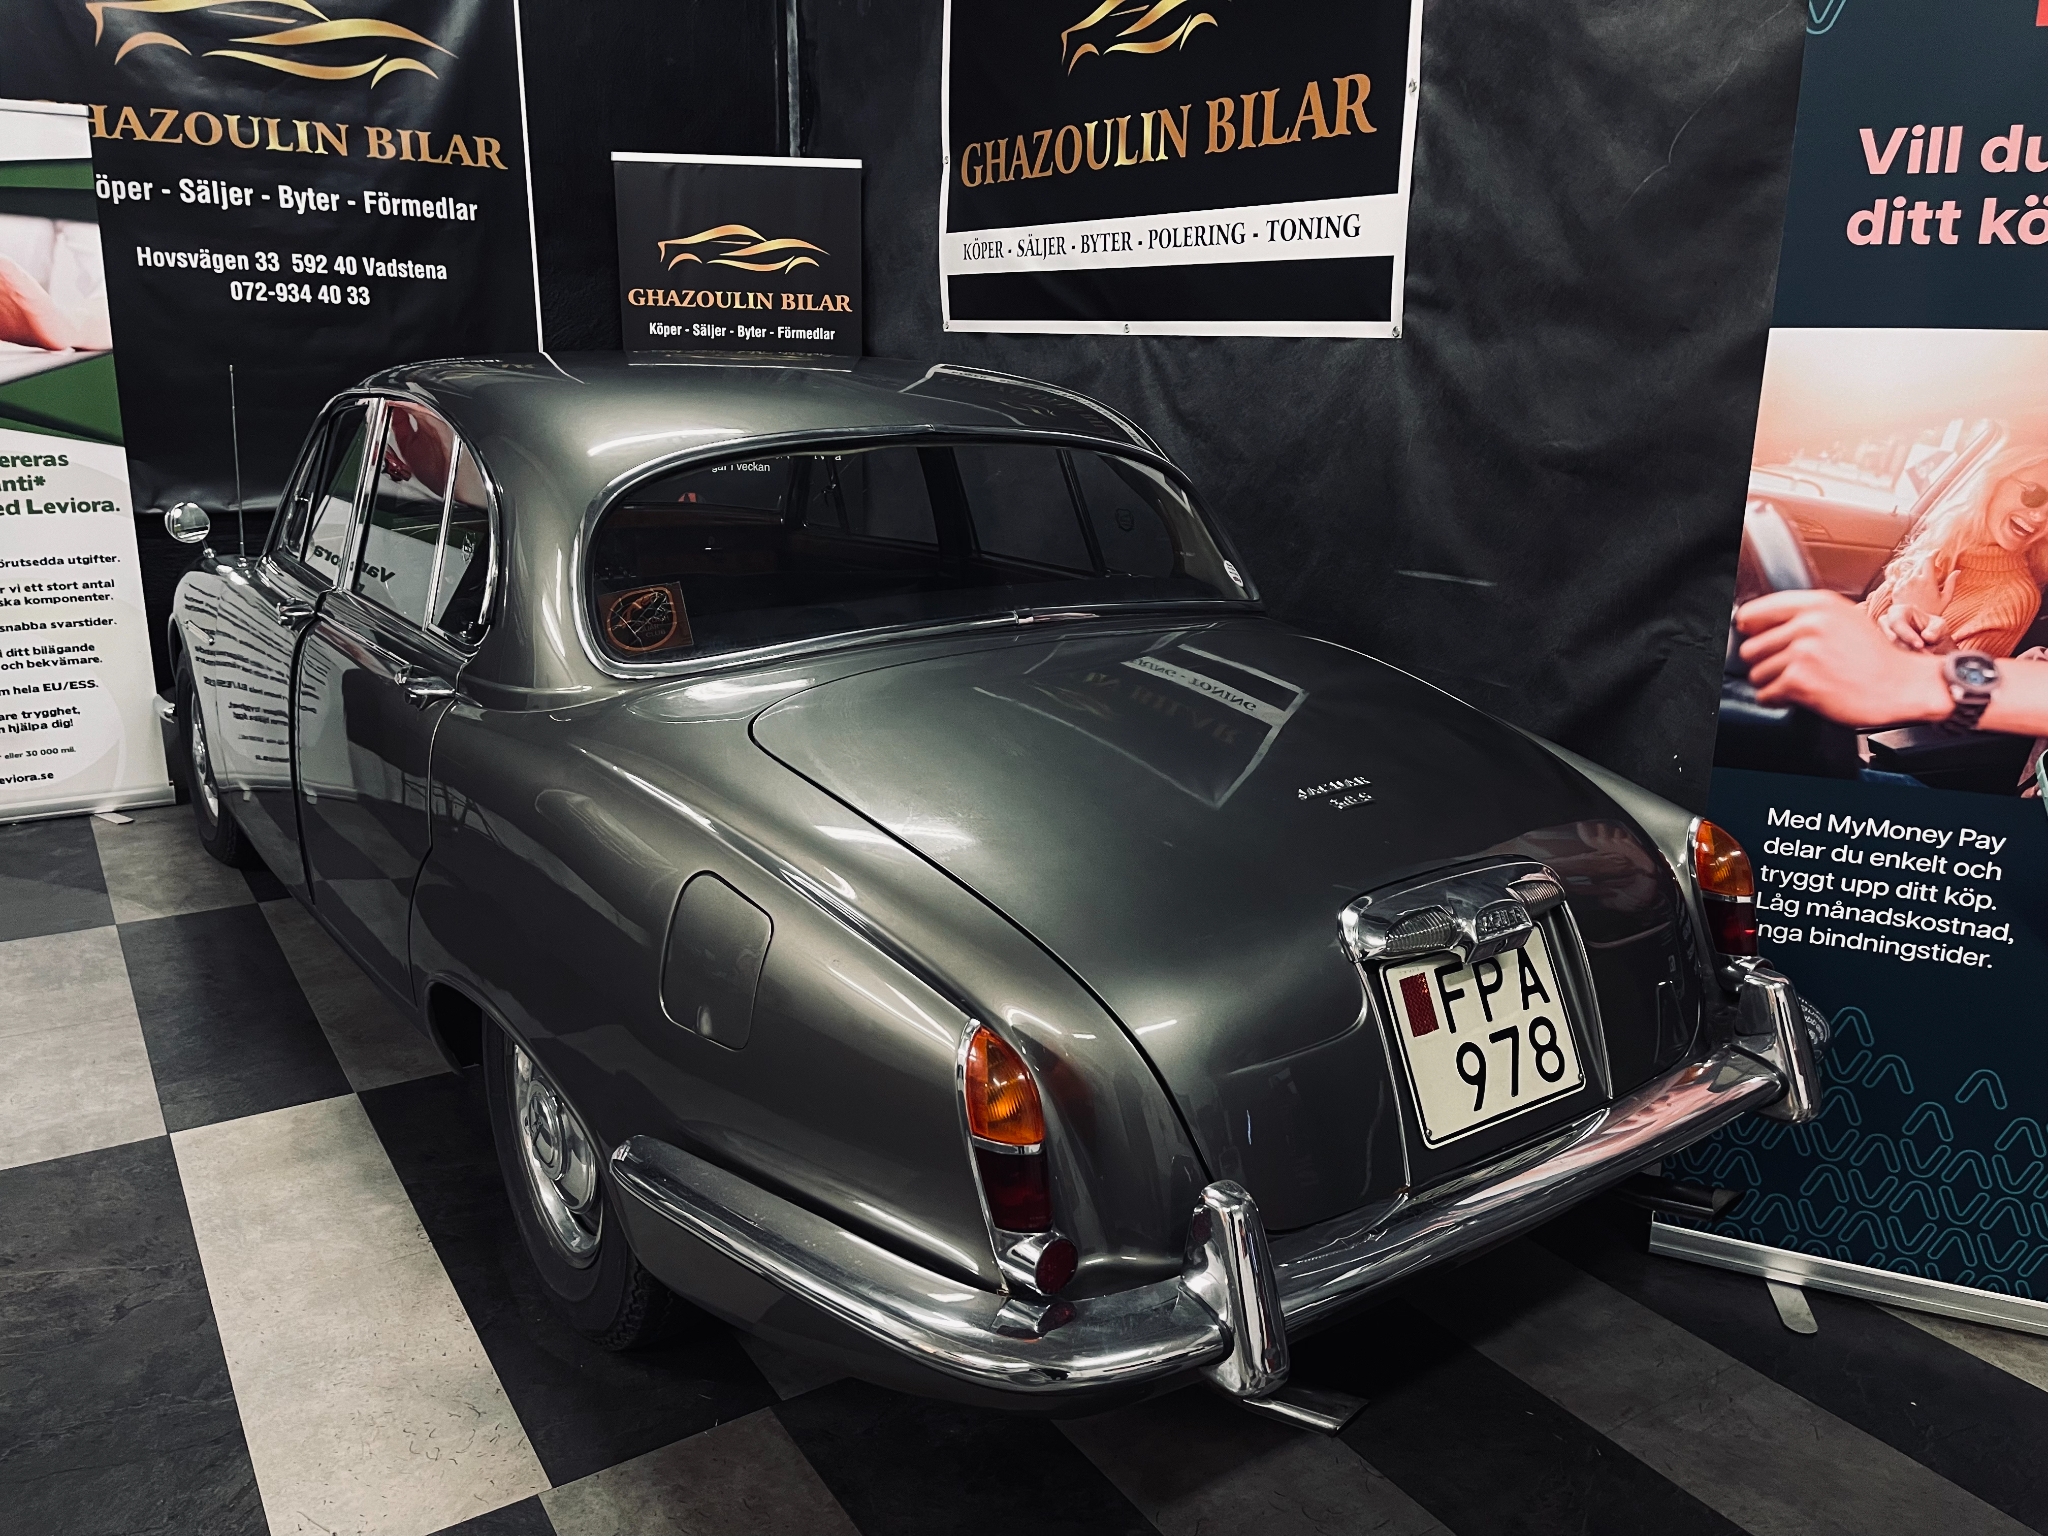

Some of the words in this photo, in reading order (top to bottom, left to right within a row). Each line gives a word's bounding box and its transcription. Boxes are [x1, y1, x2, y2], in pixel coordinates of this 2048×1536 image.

[960, 104, 1192, 188] GHAZOULIN
[1204, 72, 1378, 156] BILAR
[365, 125, 508, 170] BILAR
[1859, 124, 1963, 175] Vill
[179, 178, 254, 210] Säljer
[279, 185, 339, 214] Byter
[364, 190, 478, 221] Förmedlar
[1846, 195, 1962, 246] ditt
[963, 238, 1004, 261] KÖPER
[1016, 234, 1067, 261] SÄLJER
[1080, 231, 1133, 255] BYTER
[1147, 222, 1247, 251] POLERING
[1265, 213, 1361, 243] TONING
[136, 246, 249, 274] Hovsvägen
[255, 252, 280, 272] 33
[291, 254, 328, 274] 592
[334, 256, 358, 276] 40
[362, 257, 448, 280] Vadstena
[231, 281, 312, 304] 072-934
[317, 285, 342, 305] 40
[346, 286, 371, 306] 33
[628, 288, 773, 310] GHAZOULIN
[780, 293, 853, 312] BILAR
[649, 322, 682, 338] Köper
[692, 323, 726, 339] Säljer
[737, 325, 767, 341] Byter
[777, 326, 836, 341] Förmedlar
[736, 461, 771, 472] veckan
[0, 474, 46, 492] nti
[26, 497, 121, 515] Leviora.
[67, 554, 121, 566] utgifter.
[9, 583, 21, 594] vi
[24, 583, 44, 593] ett
[47, 581, 79, 592] stort
[82, 579, 115, 589] antal
[24, 592, 114, 605] komponenter.
[50, 617, 118, 630] svarstider.
[6, 648, 30, 658] ditt
[32, 643, 95, 656] bilägande
[1, 660, 24, 671] och
[26, 656, 103, 669] bekvämare.
[13, 684, 40, 695] hela
[43, 679, 99, 692] EU/ESS.
[21, 706, 81, 719] trygghet,
[8, 721, 48, 734] hjälpa
[51, 718, 74, 730] dig!
[4, 752, 24, 760] eller
[25, 749, 38, 757] 30
[40, 747, 59, 756] 000
[1767, 807, 1822, 831] Med
[1827, 813, 1954, 849] MyMoney
[1958, 828, 2007, 856] Pay
[1763, 836, 1826, 860] delar
[1831, 844, 1864, 865] du
[1869, 850, 1948, 875] enkelt
[1953, 861, 2002, 881] och
[1760, 864, 1835, 893] tryggt
[1840, 877, 1890, 900] upp
[1895, 881, 1940, 903] ditt
[1944, 886, 1998, 913] köp.
[1756, 891, 1800, 918] Låg
[1806, 900, 2014, 945] månadskostnad,
[1809, 926, 1993, 969] bindningstider.
[1434, 946, 1551, 1034] FPA
[1455, 1015, 1566, 1112] 978
